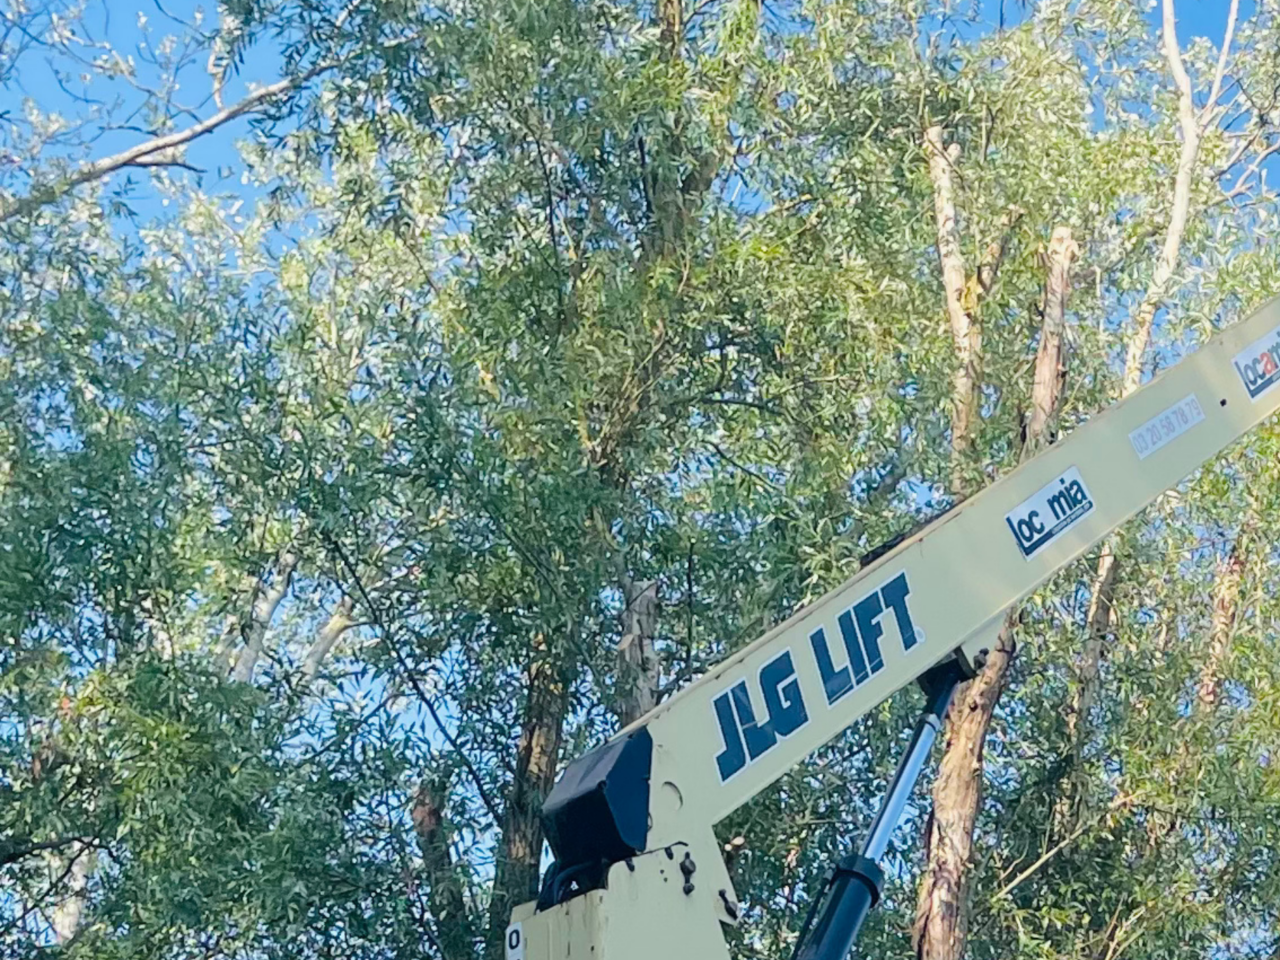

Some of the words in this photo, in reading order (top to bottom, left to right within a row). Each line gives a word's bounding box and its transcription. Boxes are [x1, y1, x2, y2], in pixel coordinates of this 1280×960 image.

[1132, 432, 1149, 454] 03
[1146, 423, 1162, 446] 20
[1159, 415, 1176, 437] 58
[1171, 406, 1188, 428] 78
[1185, 398, 1201, 420] 79
[713, 649, 810, 783] JLG
[809, 571, 918, 707] LIFT
